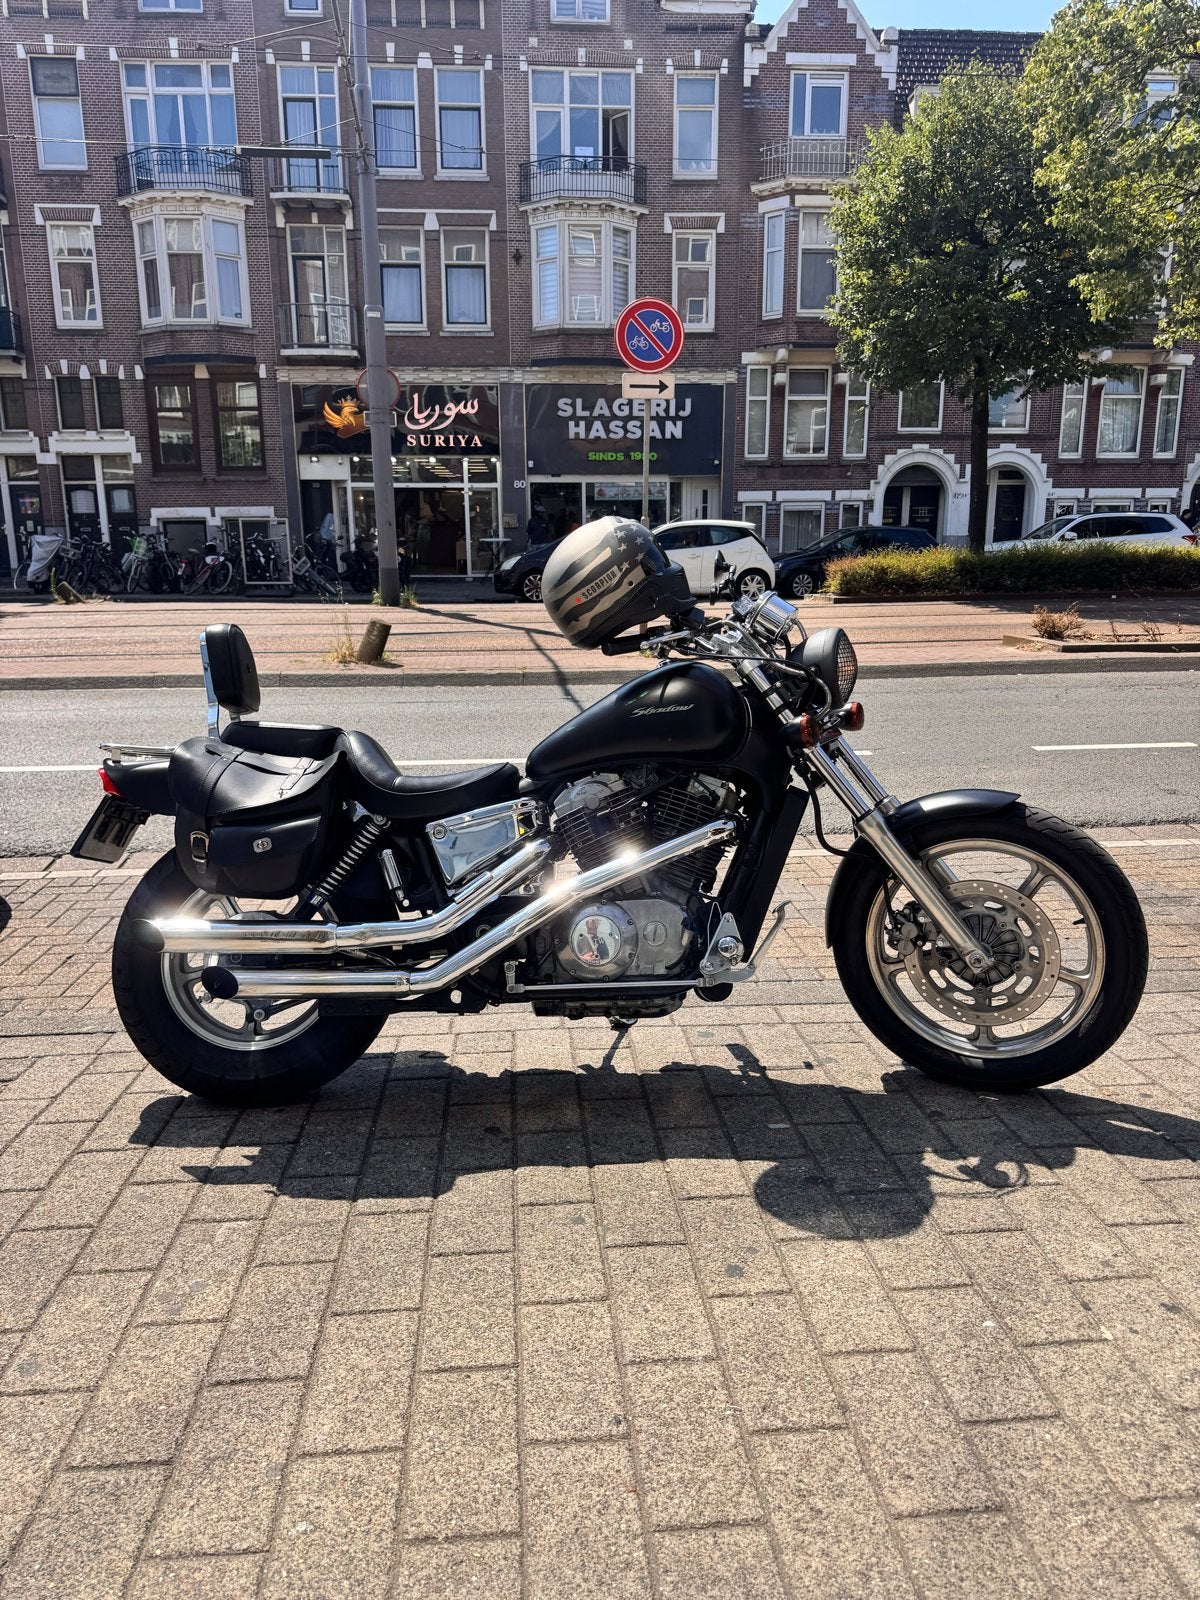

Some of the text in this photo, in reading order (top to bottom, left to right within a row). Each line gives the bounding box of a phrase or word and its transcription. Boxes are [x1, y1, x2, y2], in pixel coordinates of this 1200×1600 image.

[404, 393, 479, 430] سوريا
[557, 398, 692, 417] SLAGERIJ
[568, 420, 683, 439] HASSAN
[406, 434, 483, 447] SURIYA
[588, 451, 658, 461] SINDS 190
[513, 480, 526, 489] 80
[581, 569, 617, 600] SCORPION
[629, 703, 695, 718] Shadow
